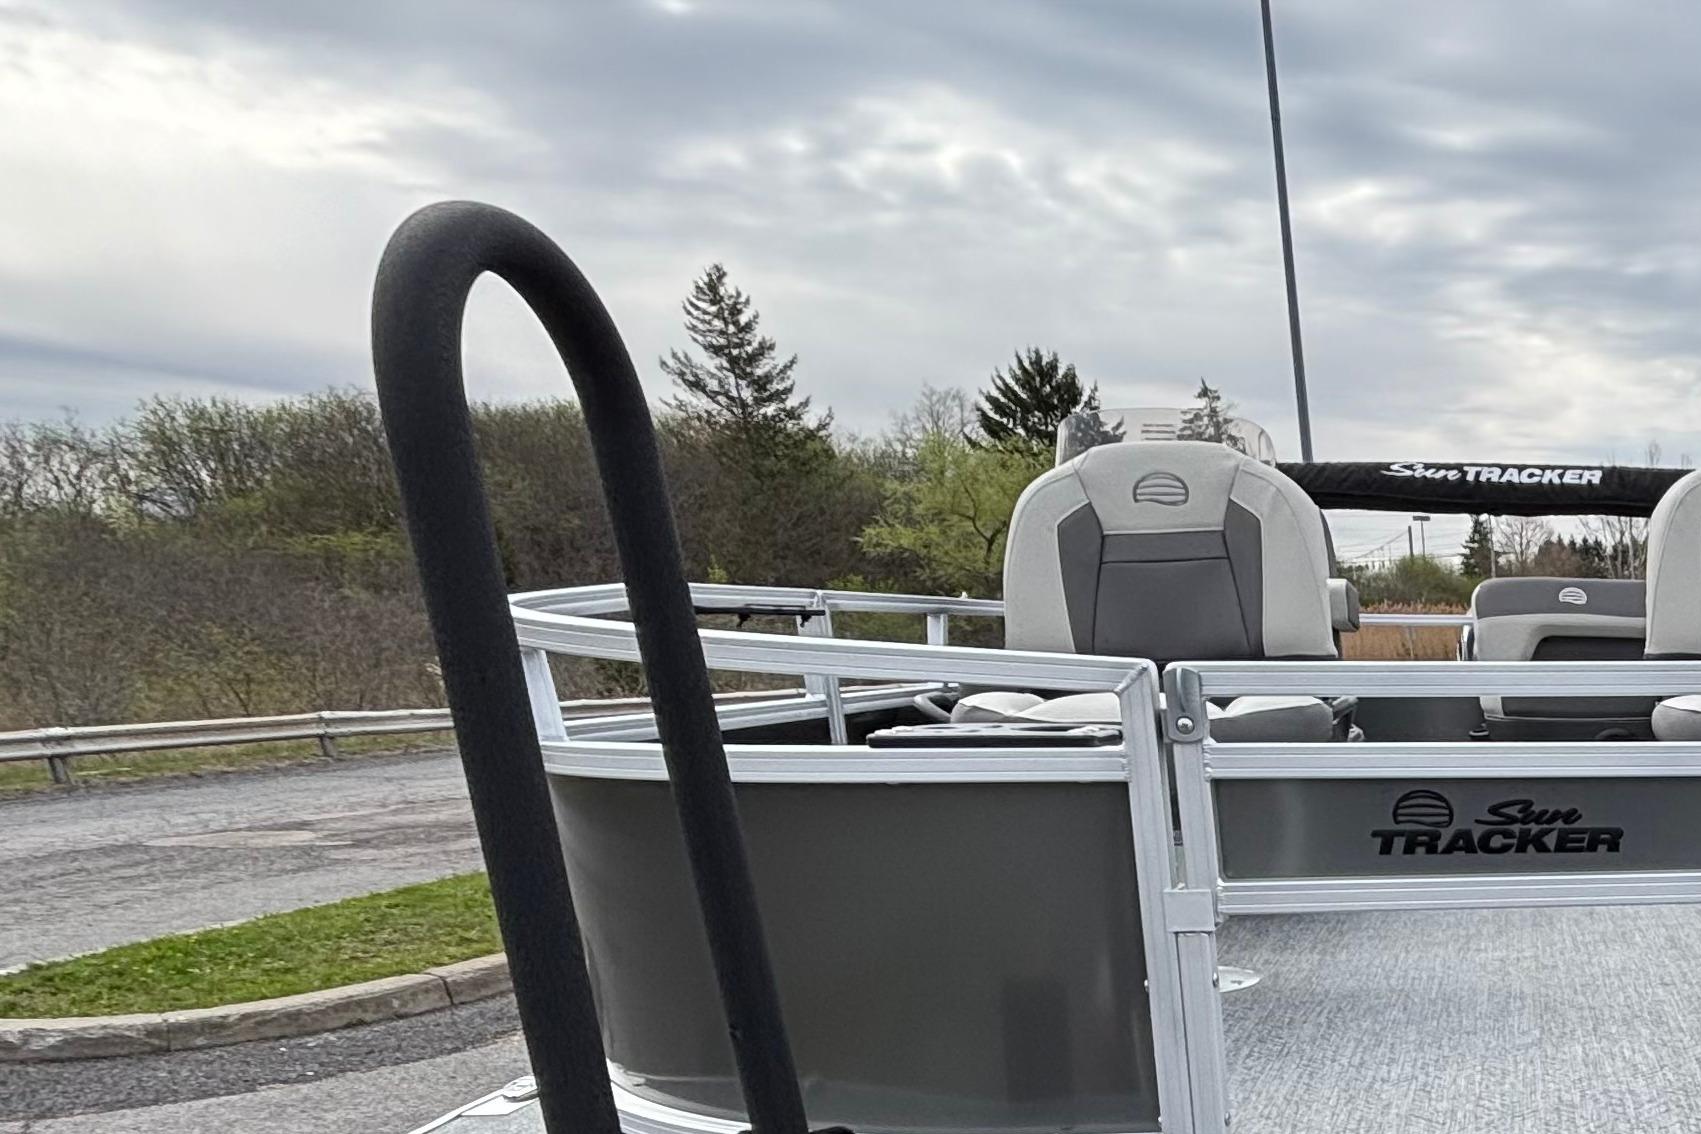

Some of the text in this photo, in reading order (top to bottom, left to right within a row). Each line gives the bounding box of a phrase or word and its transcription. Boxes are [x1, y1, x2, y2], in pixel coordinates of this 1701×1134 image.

[1380, 461, 1603, 485] Sun TRACKER
[1474, 799, 1583, 826] Sun
[1370, 827, 1625, 855] TRACKER
